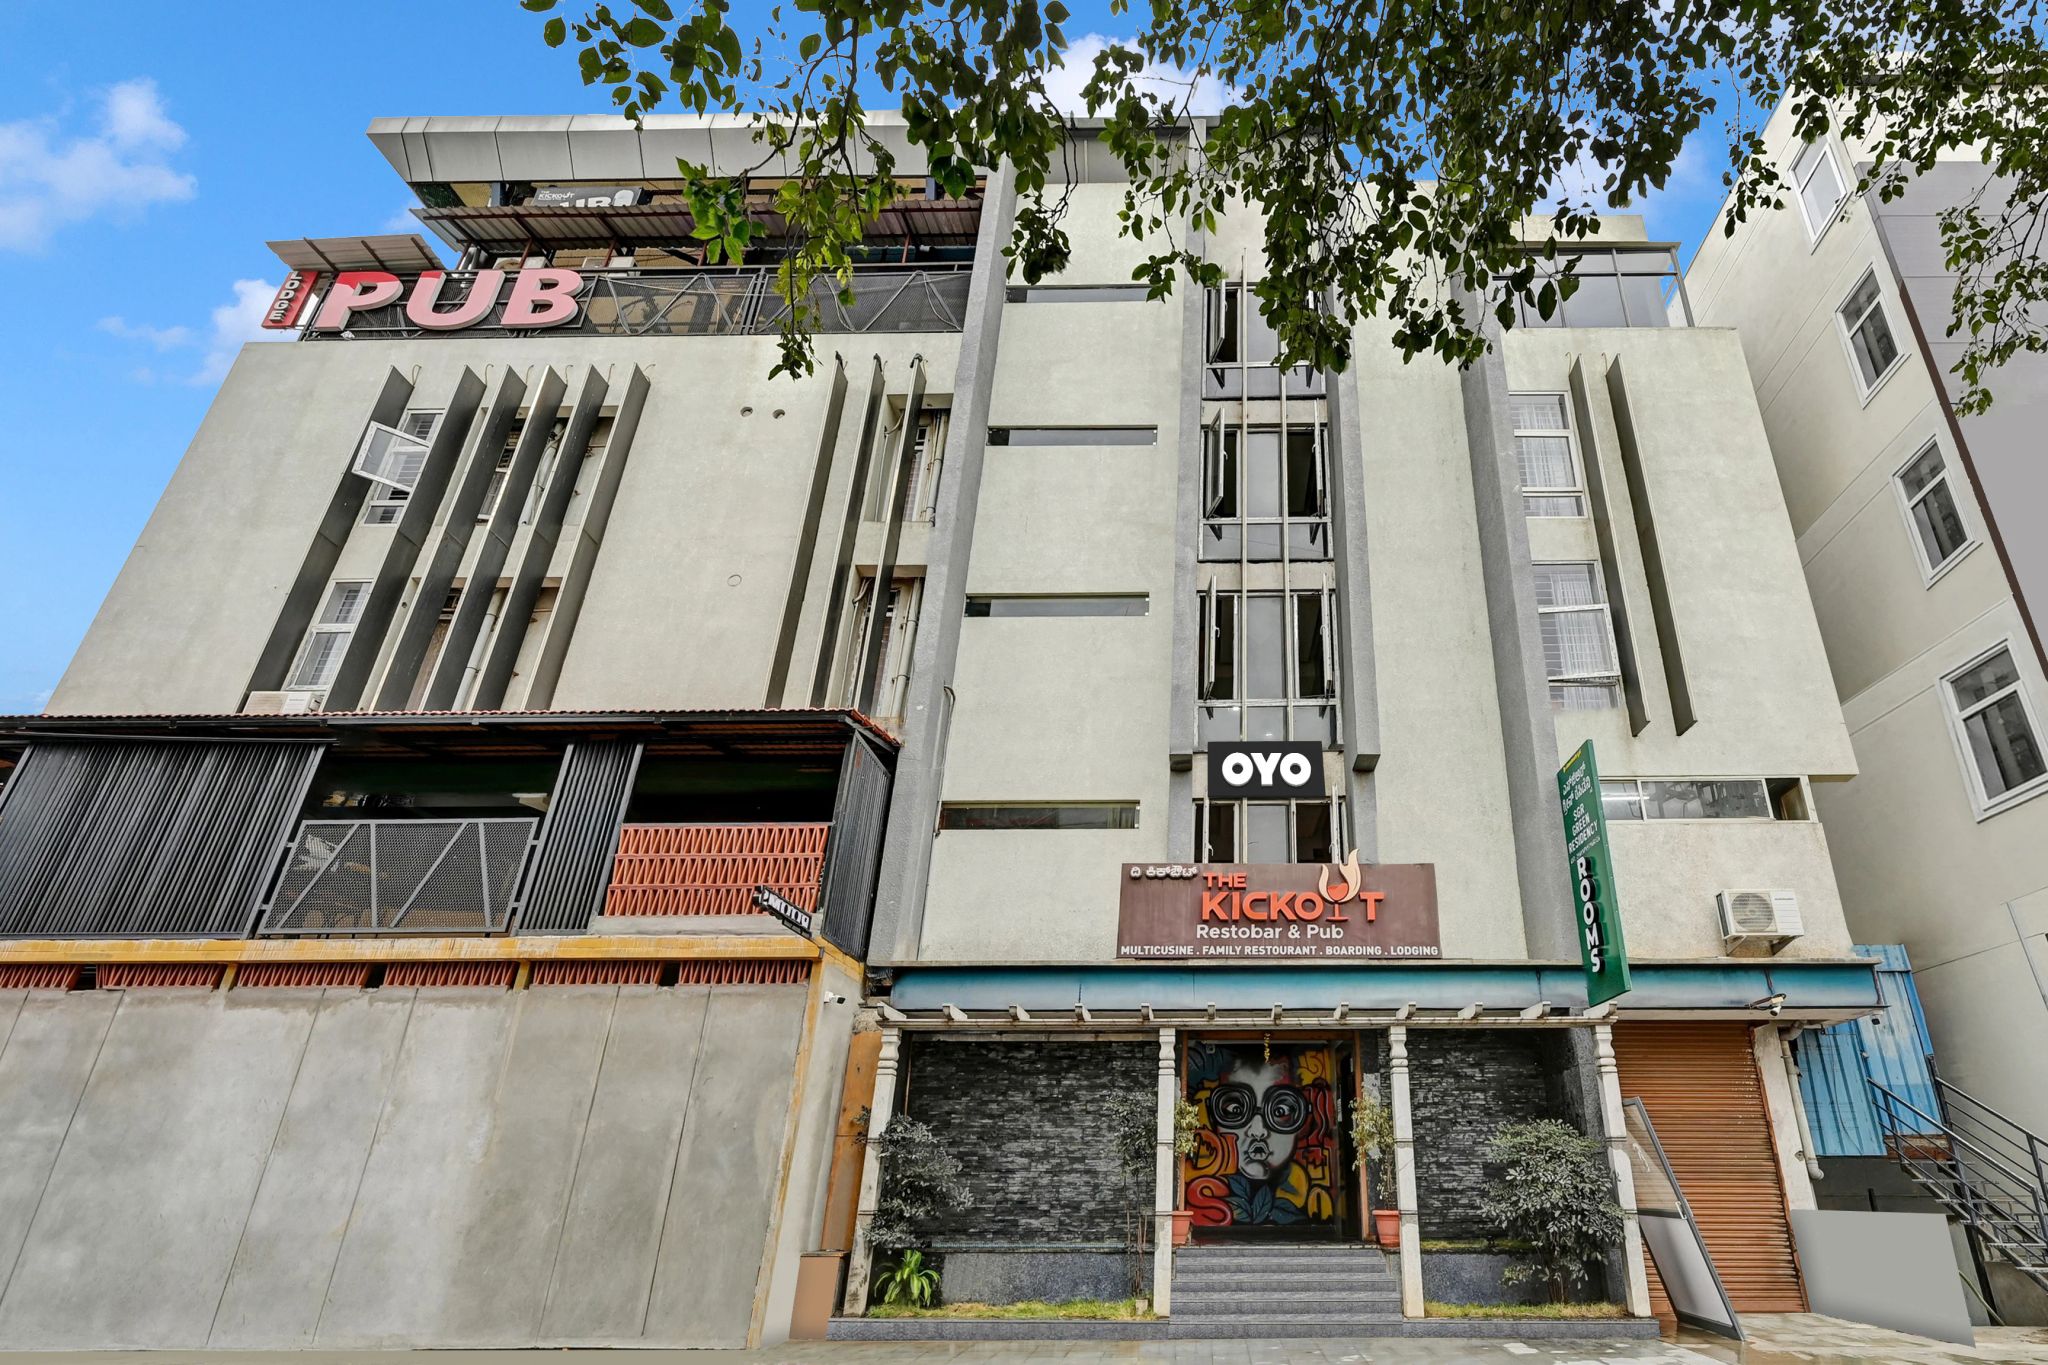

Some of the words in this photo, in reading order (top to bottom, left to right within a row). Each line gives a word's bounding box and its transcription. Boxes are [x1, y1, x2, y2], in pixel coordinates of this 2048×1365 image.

[269, 270, 302, 321] LODGE
[314, 270, 584, 331] PUB
[1222, 752, 1312, 787] OYO
[1571, 812, 1590, 837] GREEN
[1573, 803, 1585, 821] SGR
[1568, 820, 1598, 854] RESIDENCY
[1203, 872, 1248, 889] THE
[1577, 856, 1601, 973] ROOMS
[1196, 924, 1281, 939] Restobar
[1288, 924, 1301, 939] &
[1307, 924, 1344, 939] Pub
[1121, 946, 1194, 955] MULTICUSINE
[1203, 946, 1242, 955] FAMILY
[1245, 946, 1317, 955] RESTOURANT
[1326, 946, 1382, 955] BOARDING
[1391, 946, 1438, 955] LODGING
